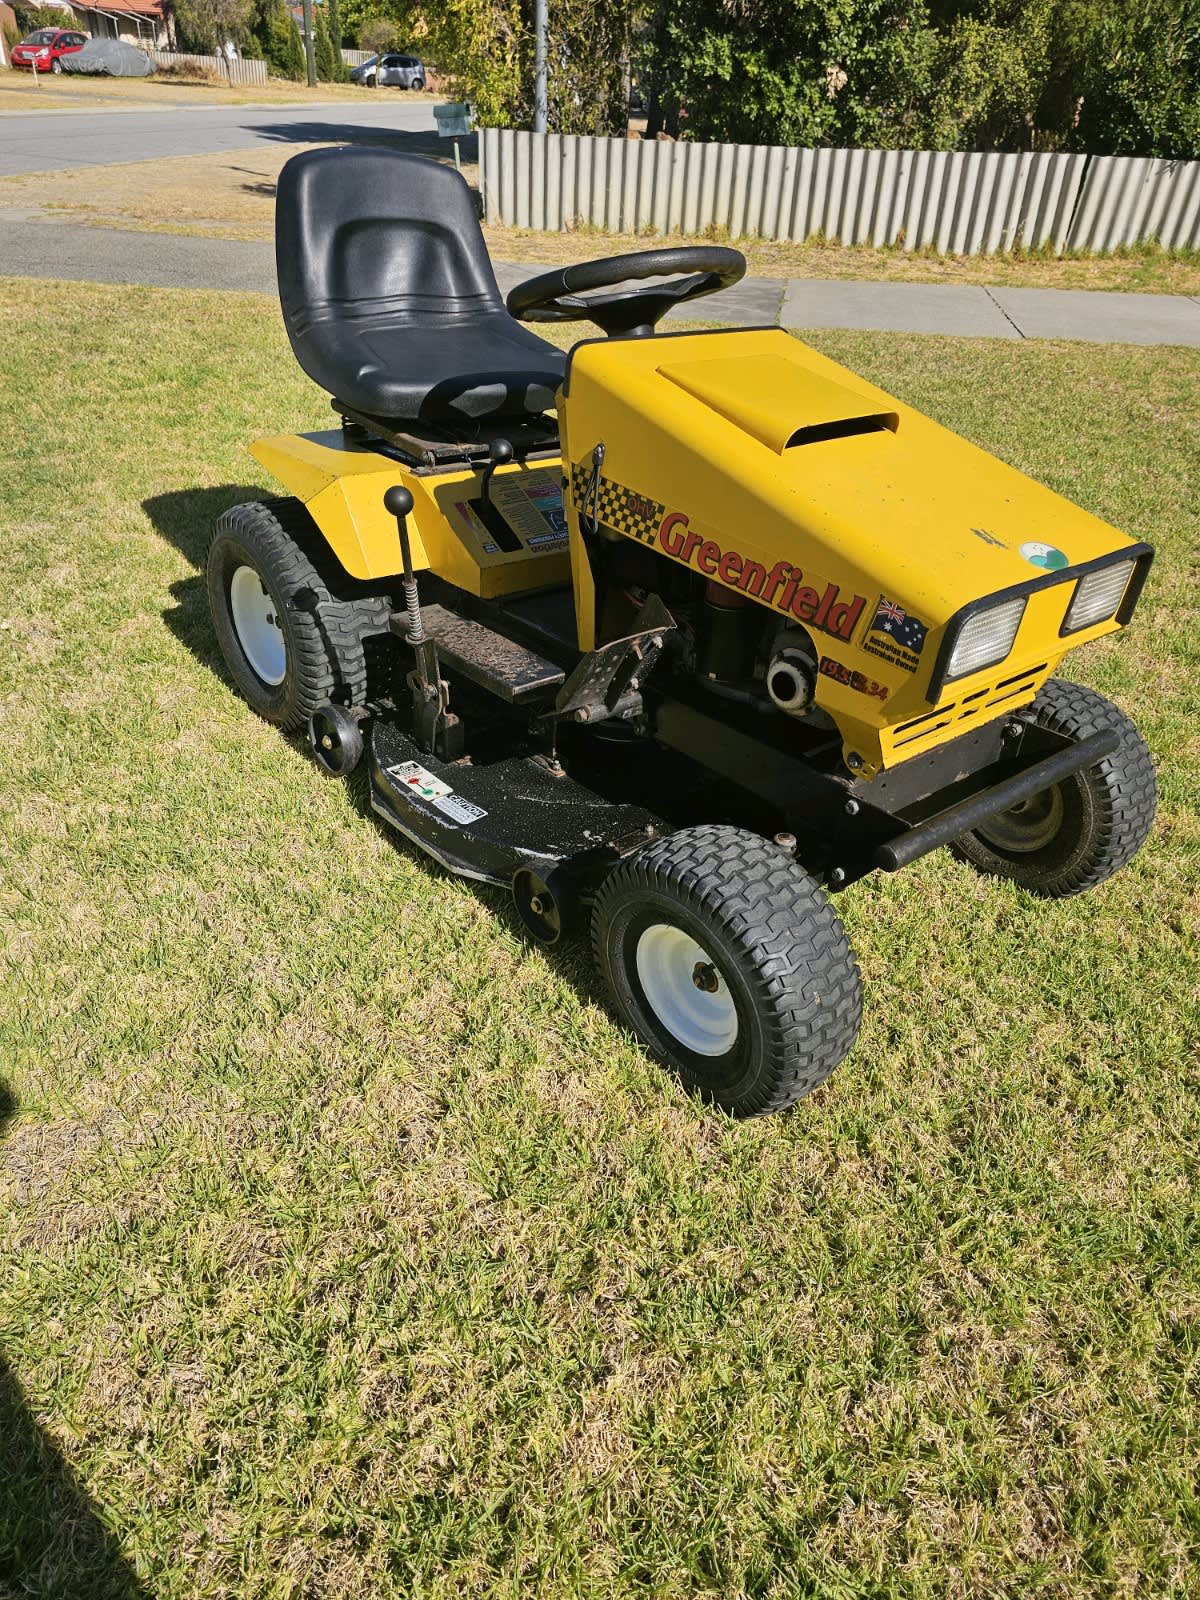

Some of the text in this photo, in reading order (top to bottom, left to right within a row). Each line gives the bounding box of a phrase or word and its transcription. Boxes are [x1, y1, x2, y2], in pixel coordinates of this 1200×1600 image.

[659, 513, 867, 642] Greenfield
[863, 642, 895, 664] Australian
[869, 636, 920, 665] Australian Made
[449, 795, 484, 817] CAUTION
